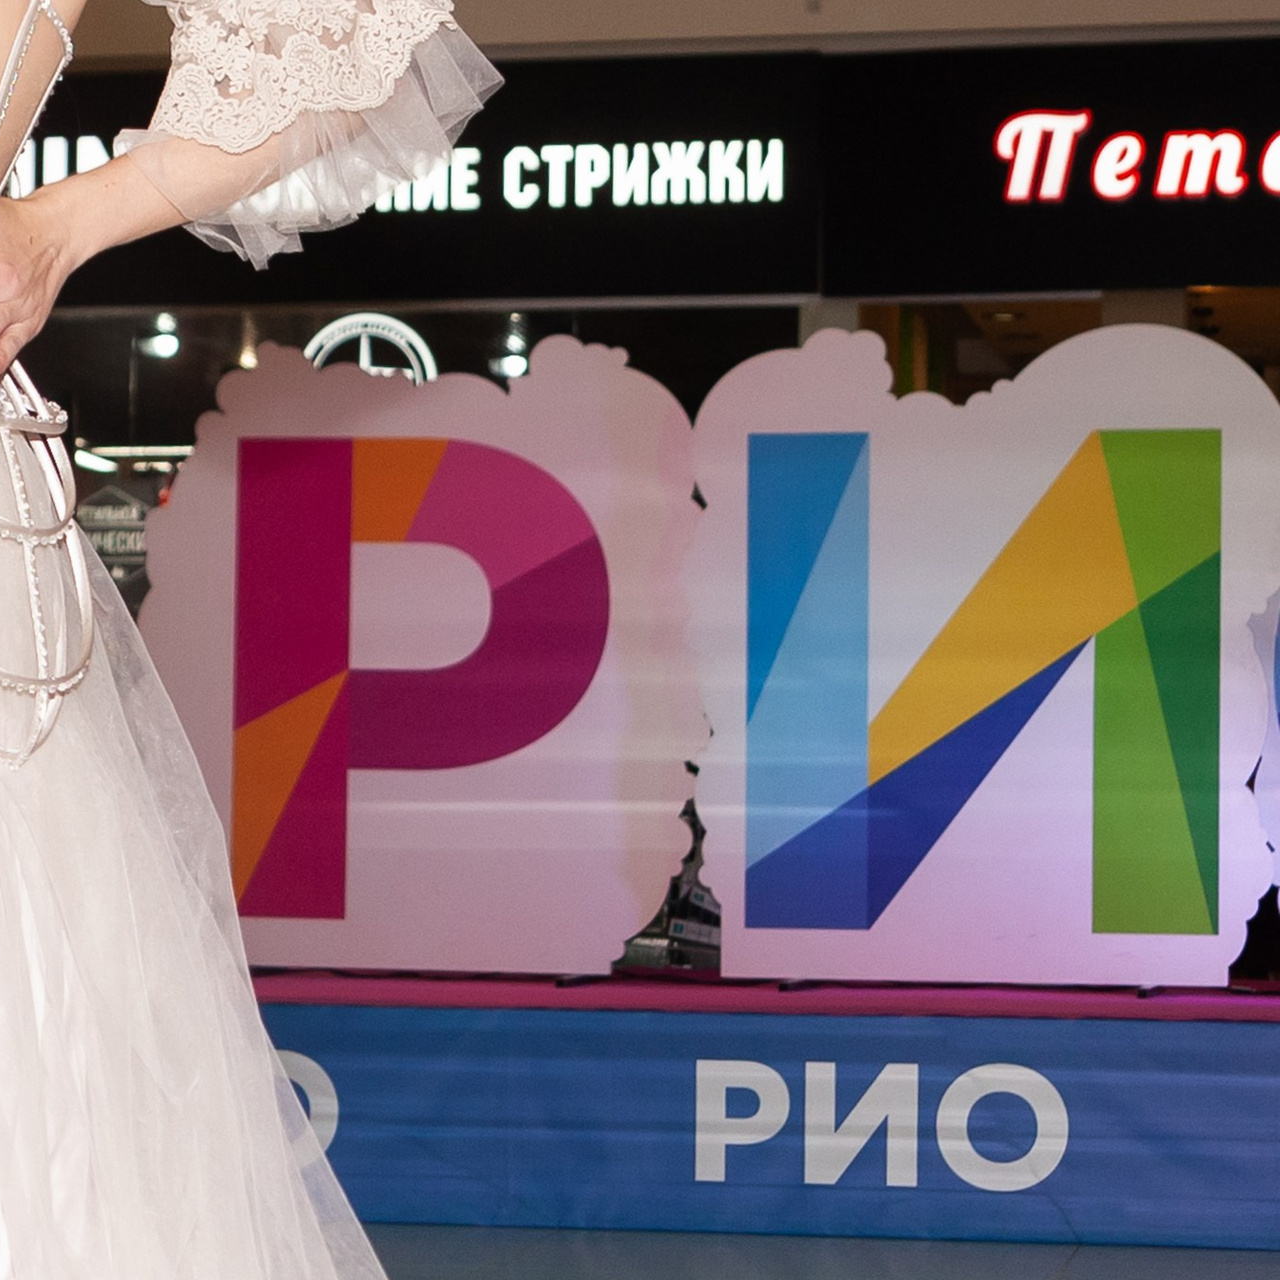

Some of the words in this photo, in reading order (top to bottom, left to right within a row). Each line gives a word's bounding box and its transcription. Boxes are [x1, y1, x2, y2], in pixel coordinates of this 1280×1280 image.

[502, 138, 784, 209] СТРИЖКИ
[231, 428, 1280, 935] РИ
[694, 1059, 1070, 1192] РИО
